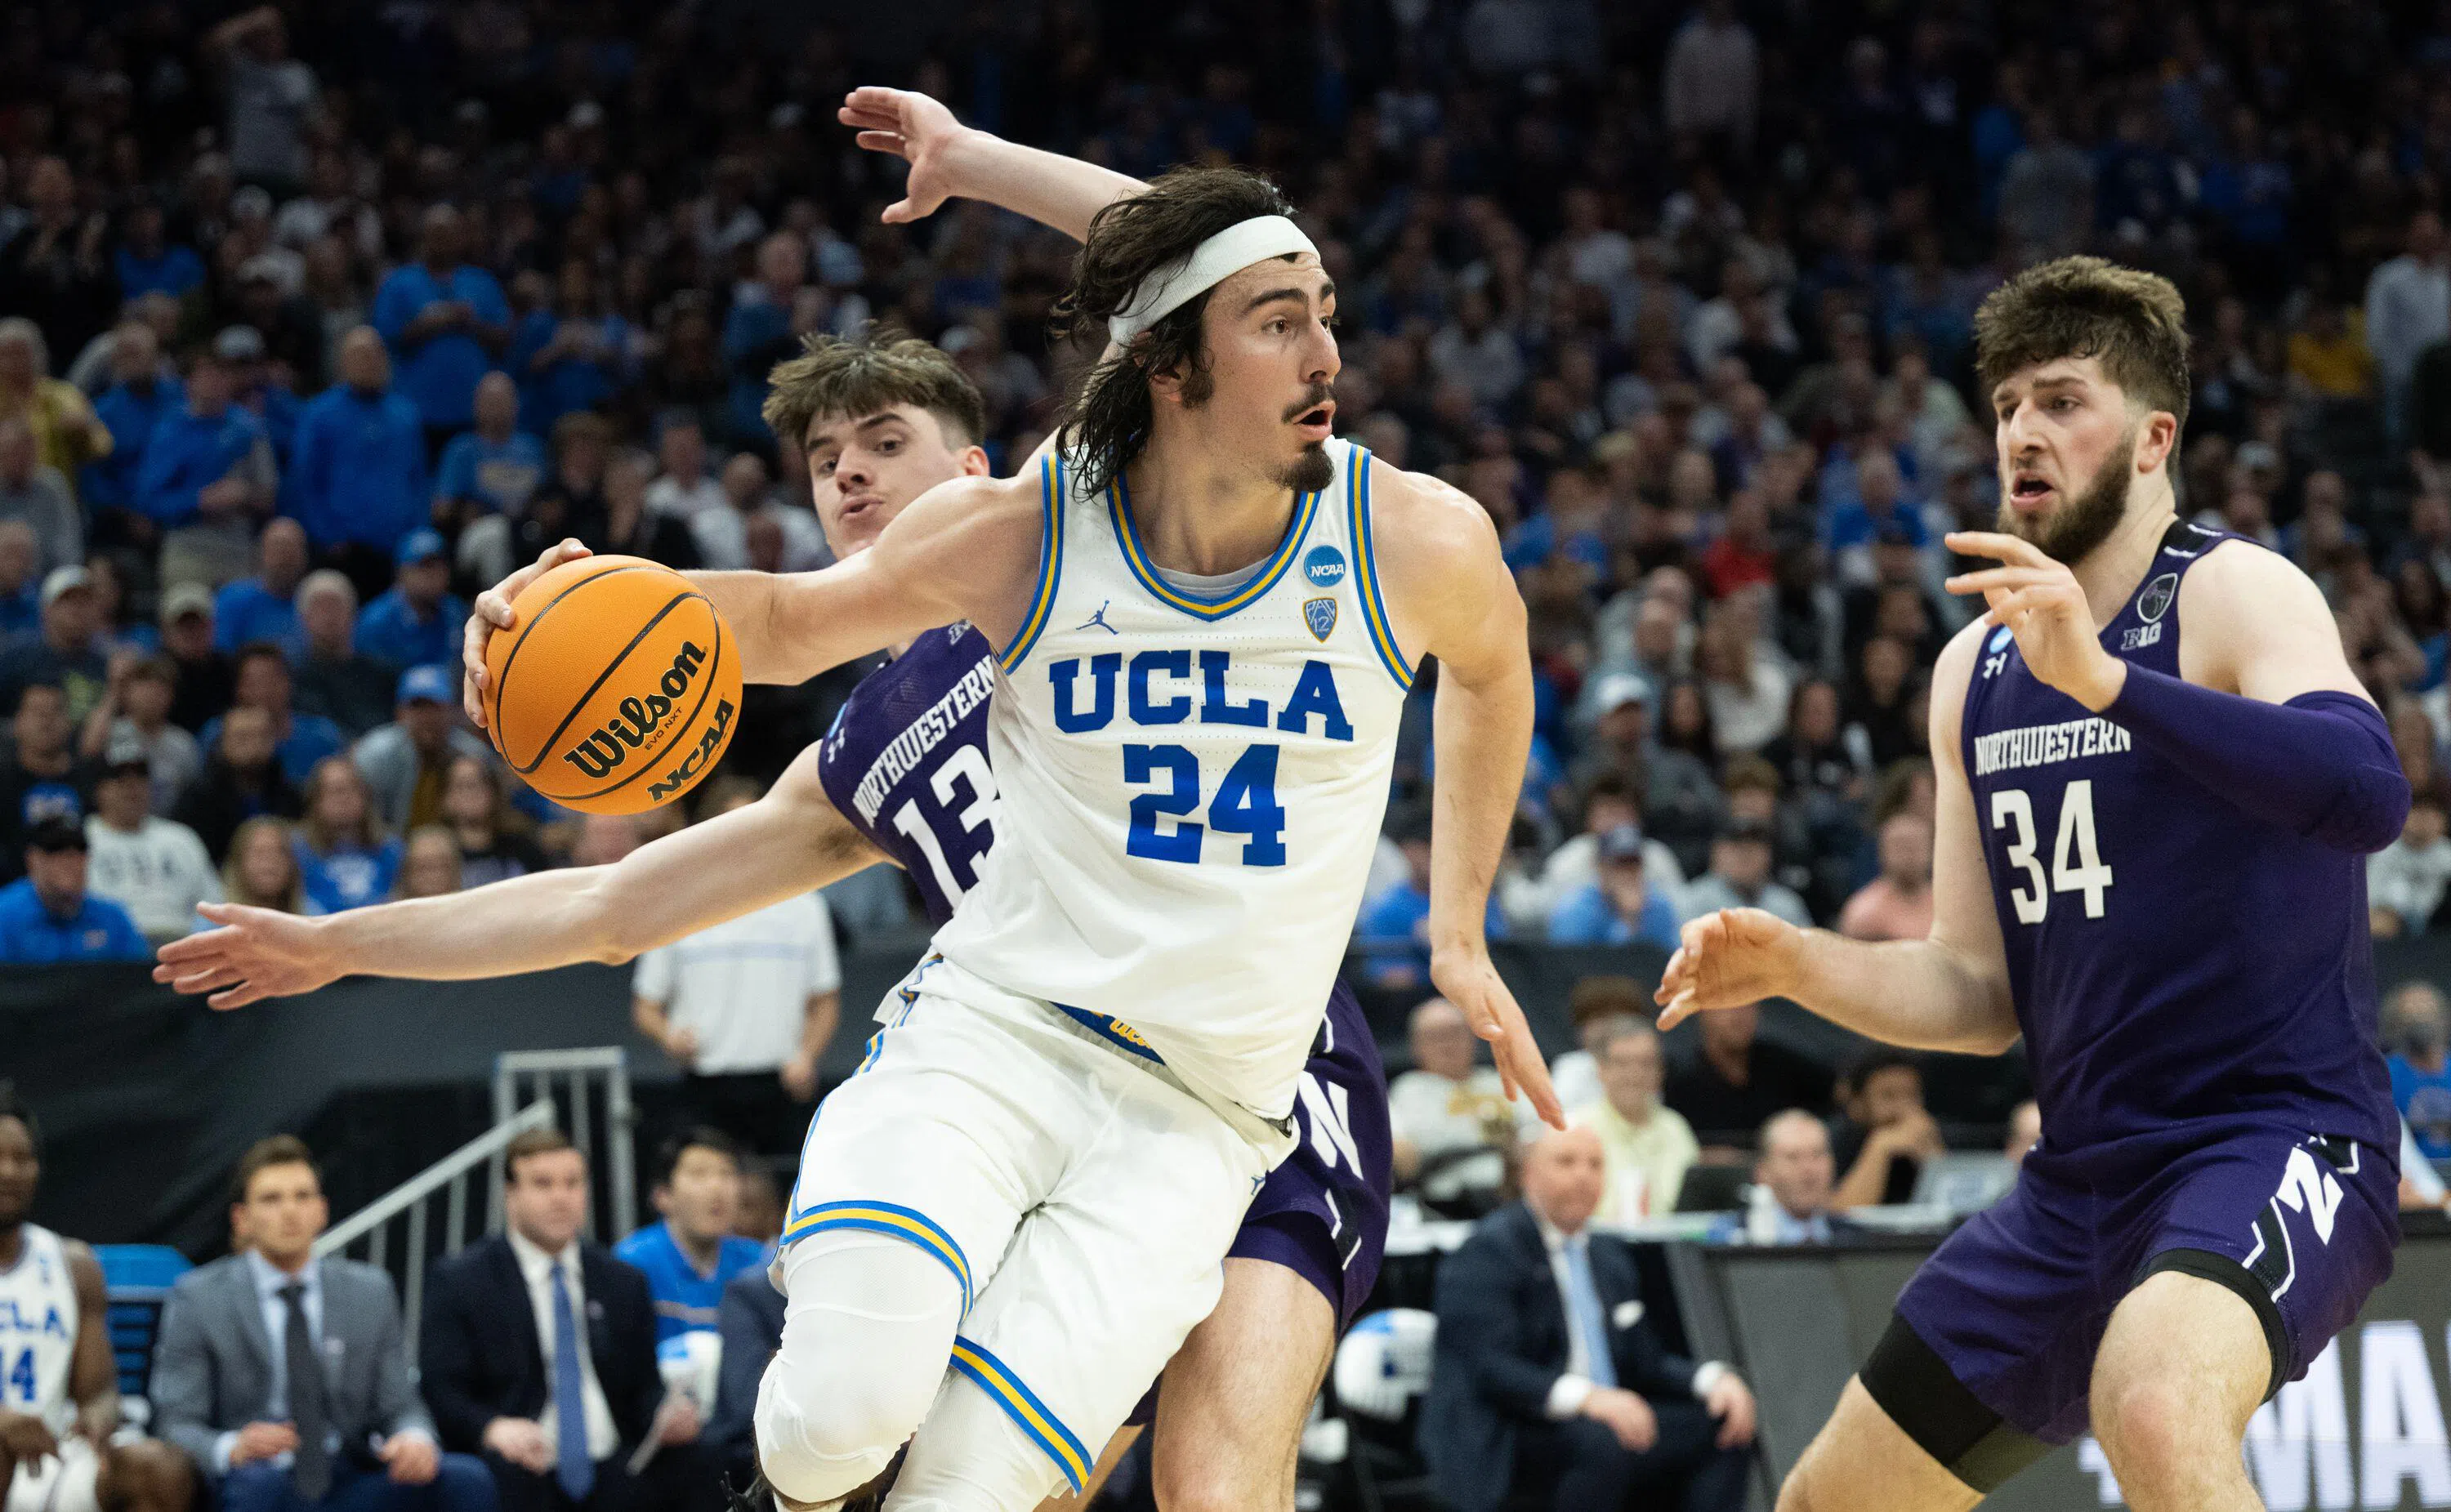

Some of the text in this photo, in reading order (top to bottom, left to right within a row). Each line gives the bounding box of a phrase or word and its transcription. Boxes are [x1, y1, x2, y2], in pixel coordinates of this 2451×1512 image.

[1310, 564, 1345, 578] NCAA
[563, 640, 707, 778] Wilson
[645, 707, 683, 751] EVO NXT
[852, 654, 995, 829] NORTHWESTERN
[1049, 649, 1354, 742] UCLA
[1974, 716, 2132, 776] NORTHWESTERN
[646, 698, 734, 802] NCAA
[892, 744, 1000, 918] 13
[1123, 743, 1286, 866] 24
[1991, 779, 2113, 925] 34
[1297, 1069, 1364, 1180] N
[2276, 1146, 2344, 1247] N
